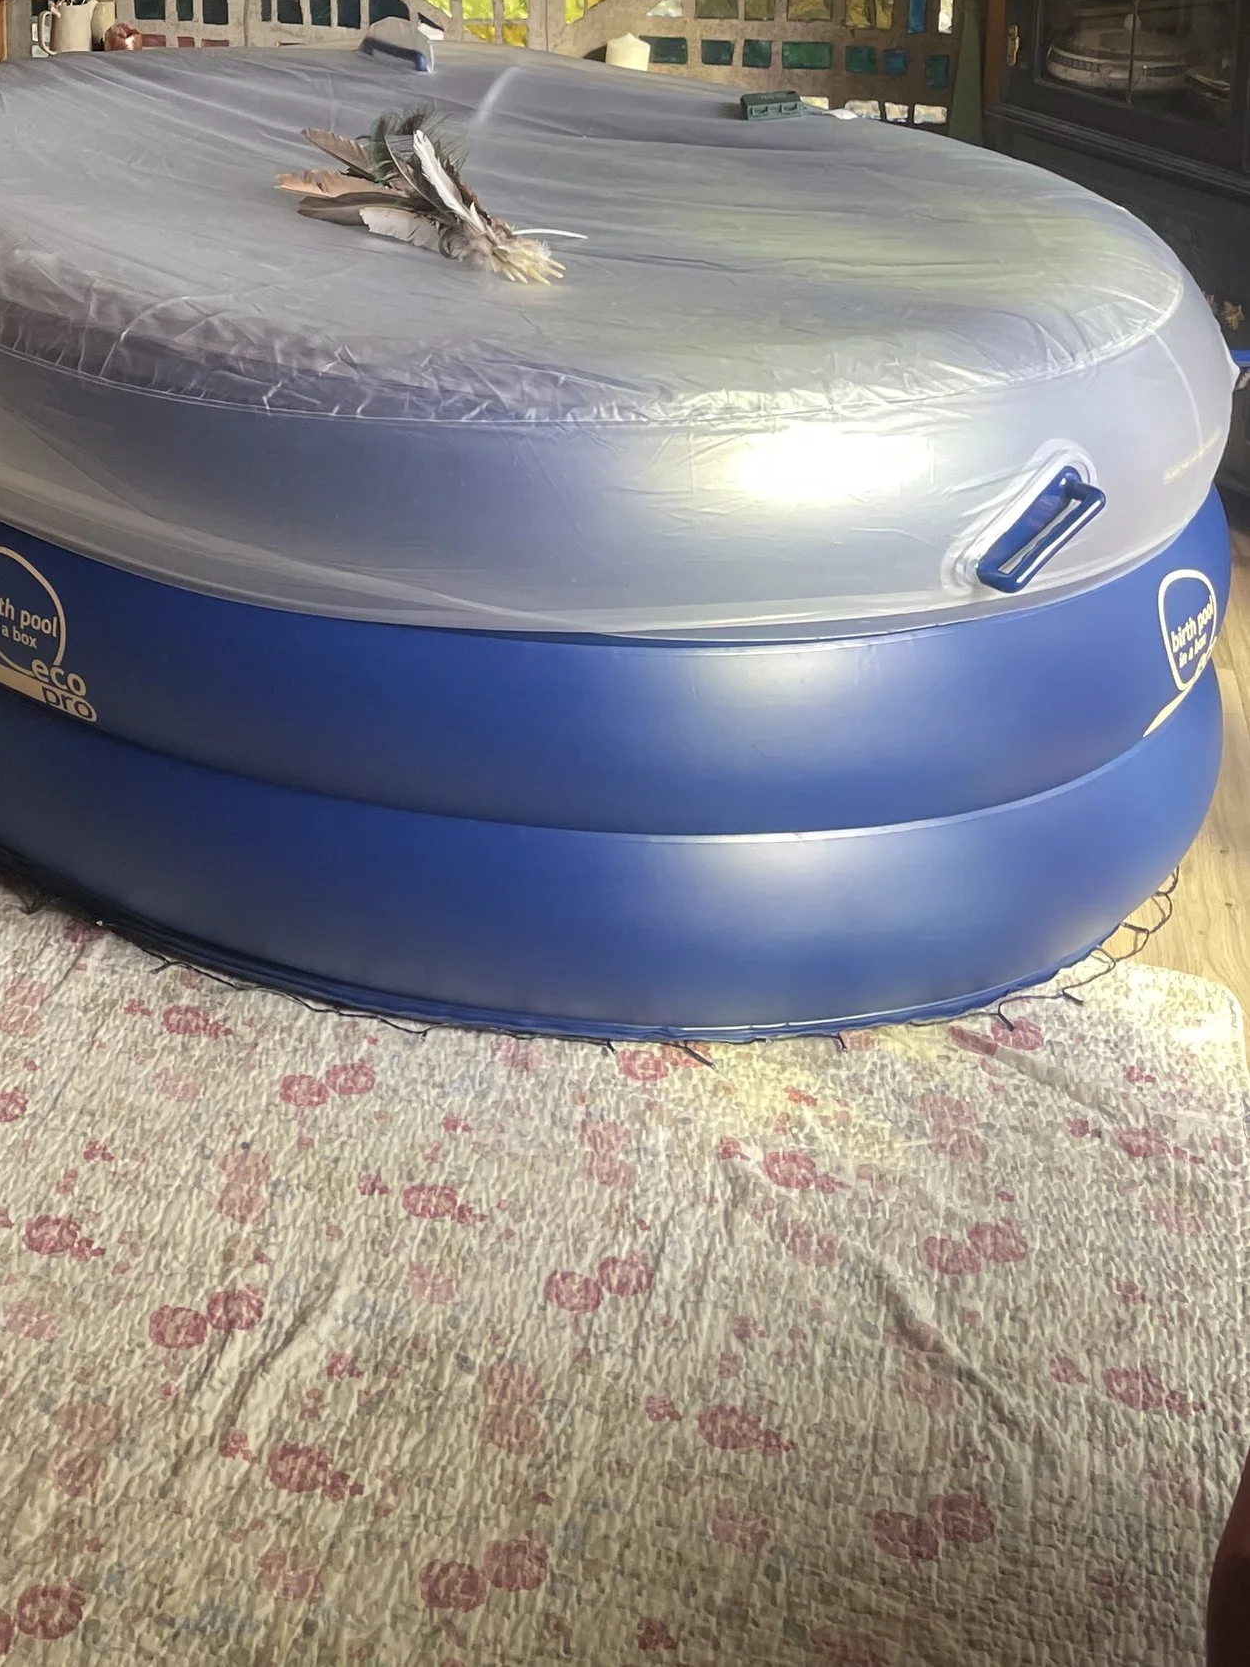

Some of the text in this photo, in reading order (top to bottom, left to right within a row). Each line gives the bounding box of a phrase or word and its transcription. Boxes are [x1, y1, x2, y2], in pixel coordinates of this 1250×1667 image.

[1, 625, 9, 638] a
[13, 626, 37, 649] box
[20, 609, 57, 637] pool
[1171, 594, 1214, 653] birth pool
[31, 659, 87, 696] eco
[42, 685, 92, 719] pro
